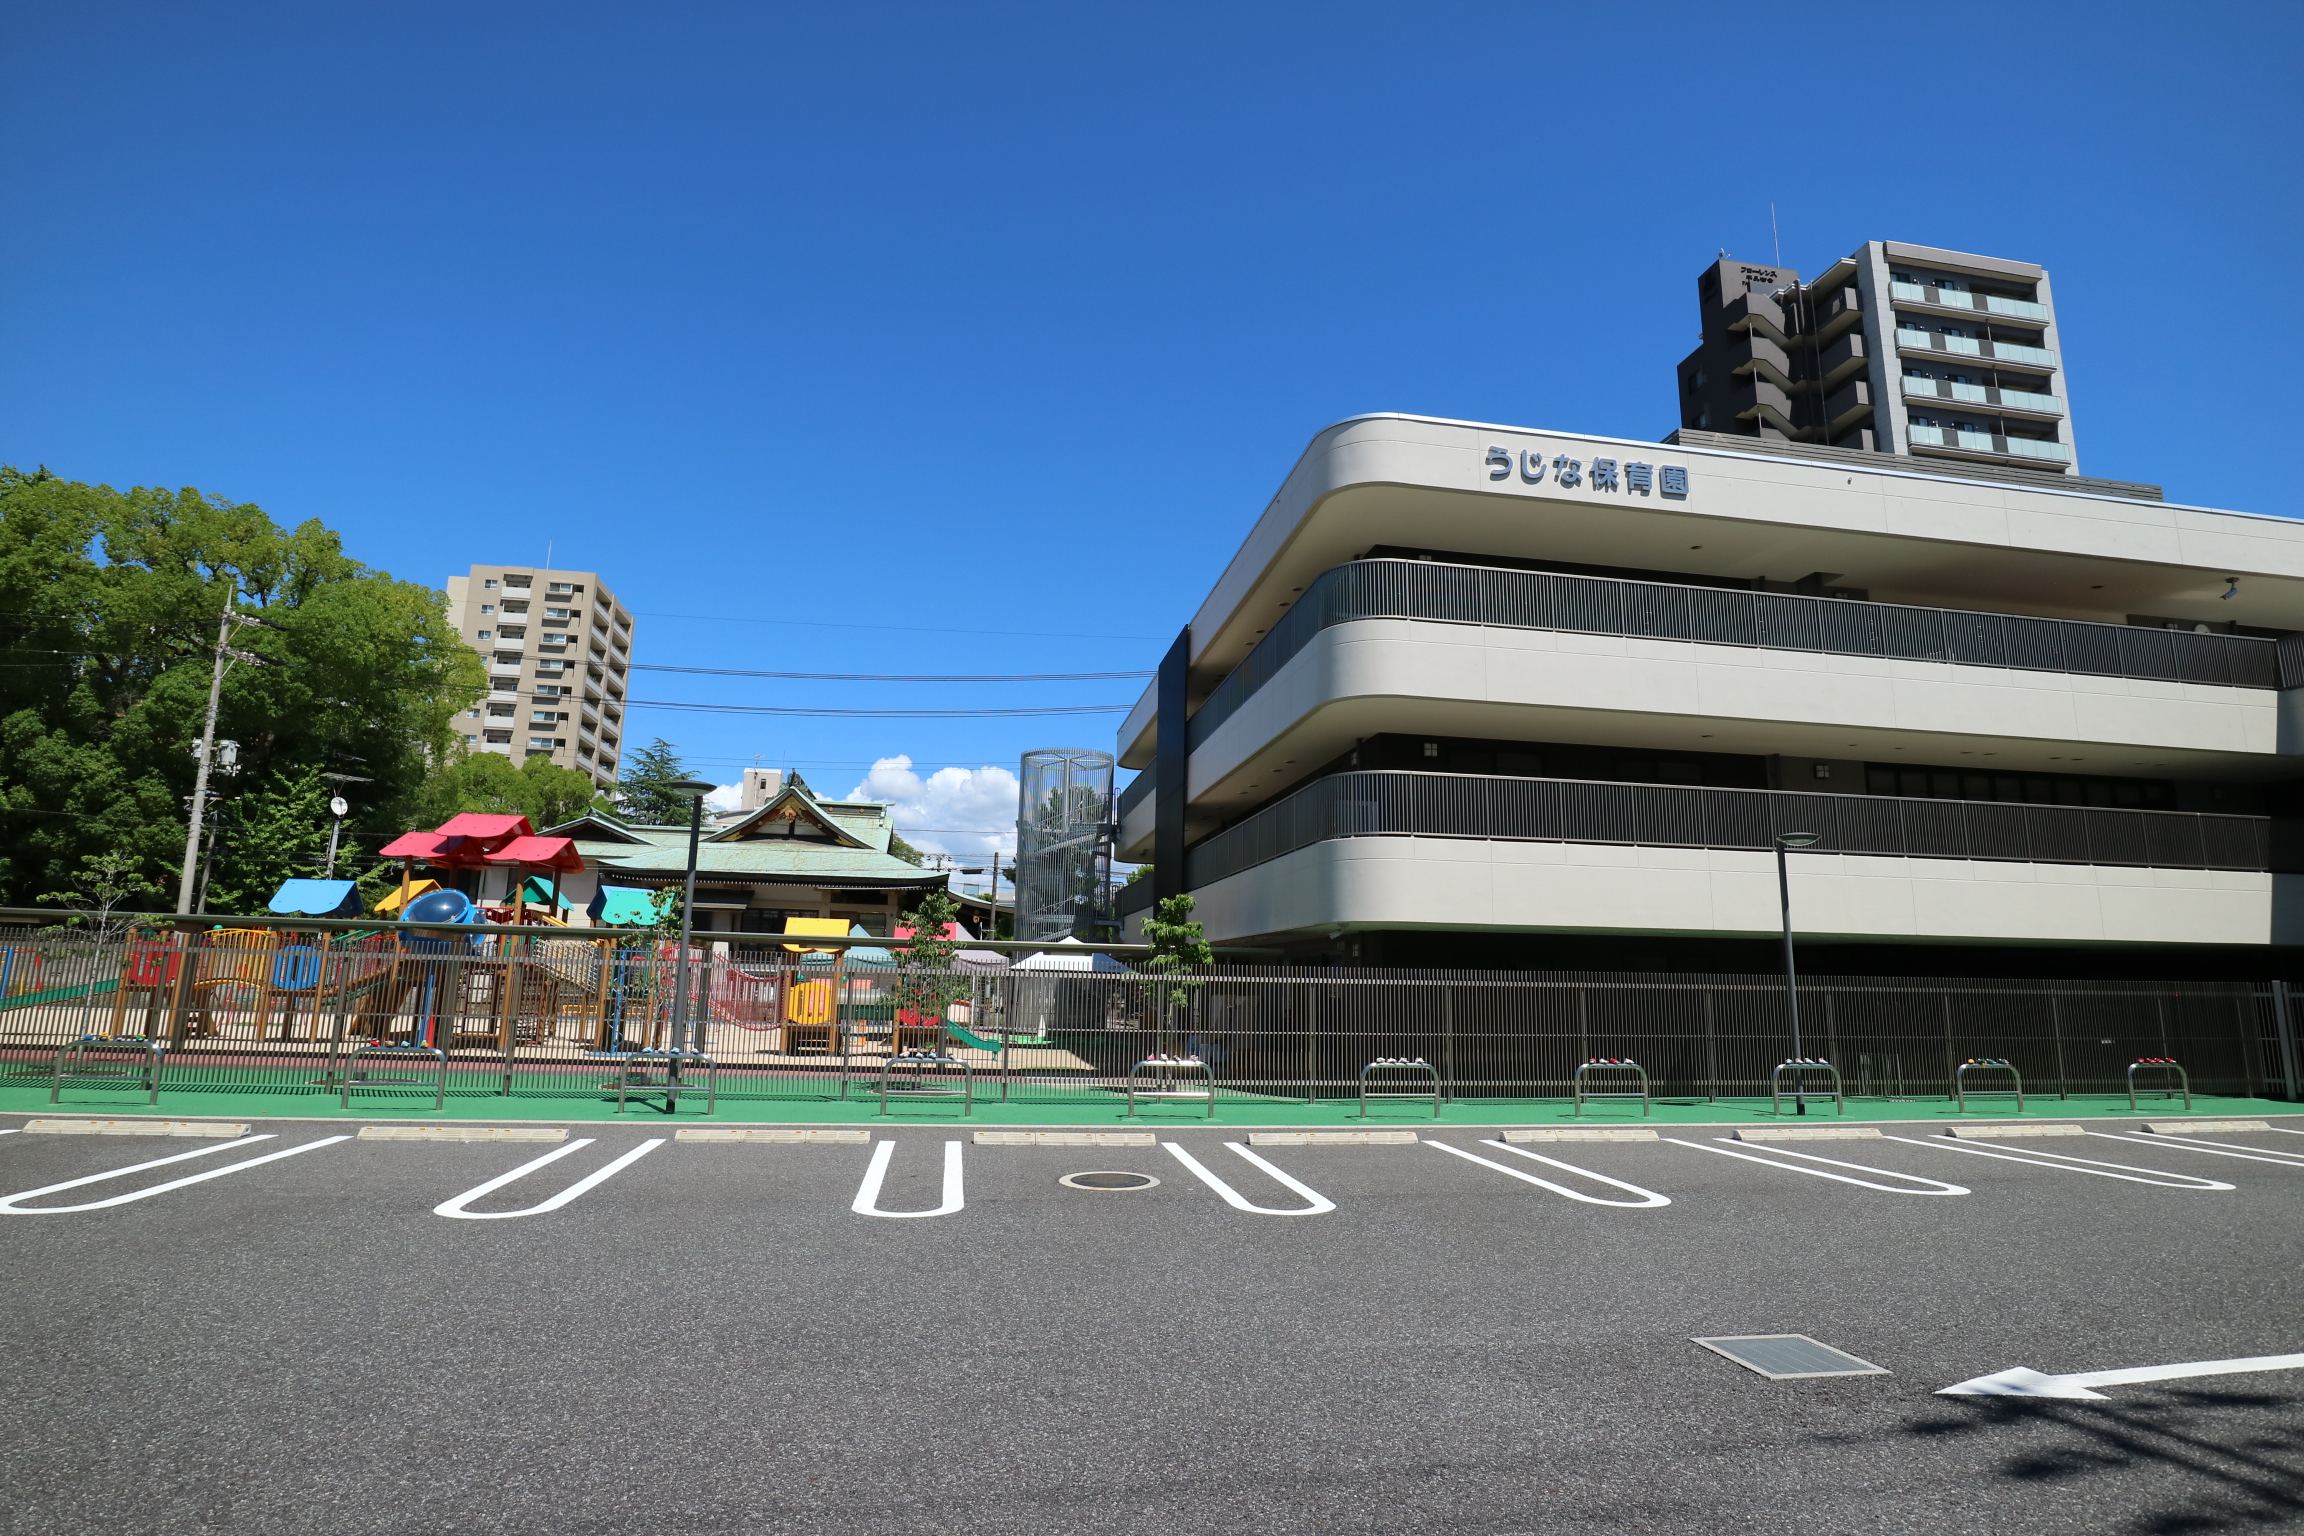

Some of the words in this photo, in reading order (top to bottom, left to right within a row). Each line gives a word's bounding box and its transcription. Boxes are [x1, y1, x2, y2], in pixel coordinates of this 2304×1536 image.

[1741, 266, 1778, 278] フローレンス
[1486, 445, 1689, 496] うじな保育園
